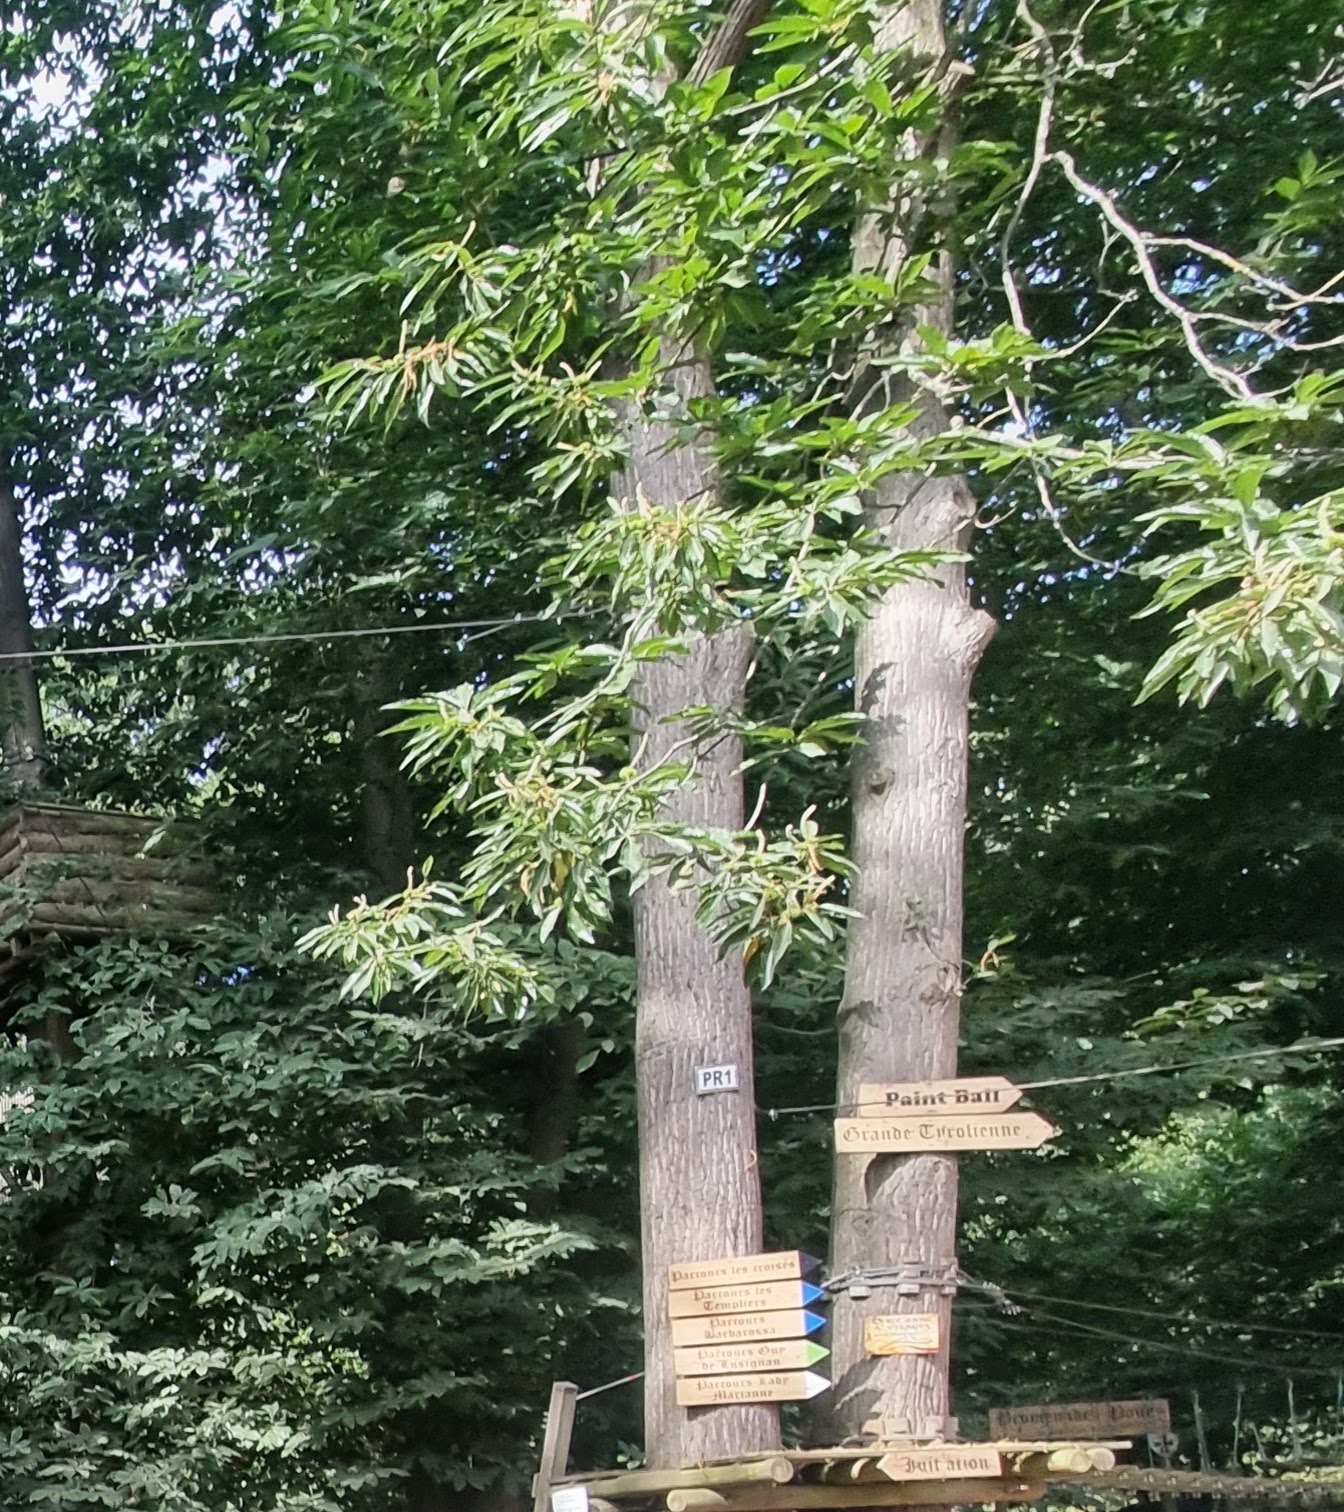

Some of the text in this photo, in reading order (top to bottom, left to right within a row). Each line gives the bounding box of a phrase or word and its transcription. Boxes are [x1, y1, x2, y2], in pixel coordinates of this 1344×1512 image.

[703, 1069, 732, 1087] PR1
[885, 1089, 1000, 1107] Paint Ball
[843, 1123, 1021, 1142] Grande Tyrolienne
[671, 1268, 727, 1283] Parcours
[732, 1266, 748, 1275] les
[694, 1286, 772, 1301] Parcours les
[703, 1299, 767, 1311] Templiers
[709, 1316, 765, 1329] Parcours
[704, 1327, 776, 1339] Barbarossa
[698, 1347, 754, 1360] Parcours
[702, 1361, 715, 1370] de
[696, 1377, 753, 1391] Parcours
